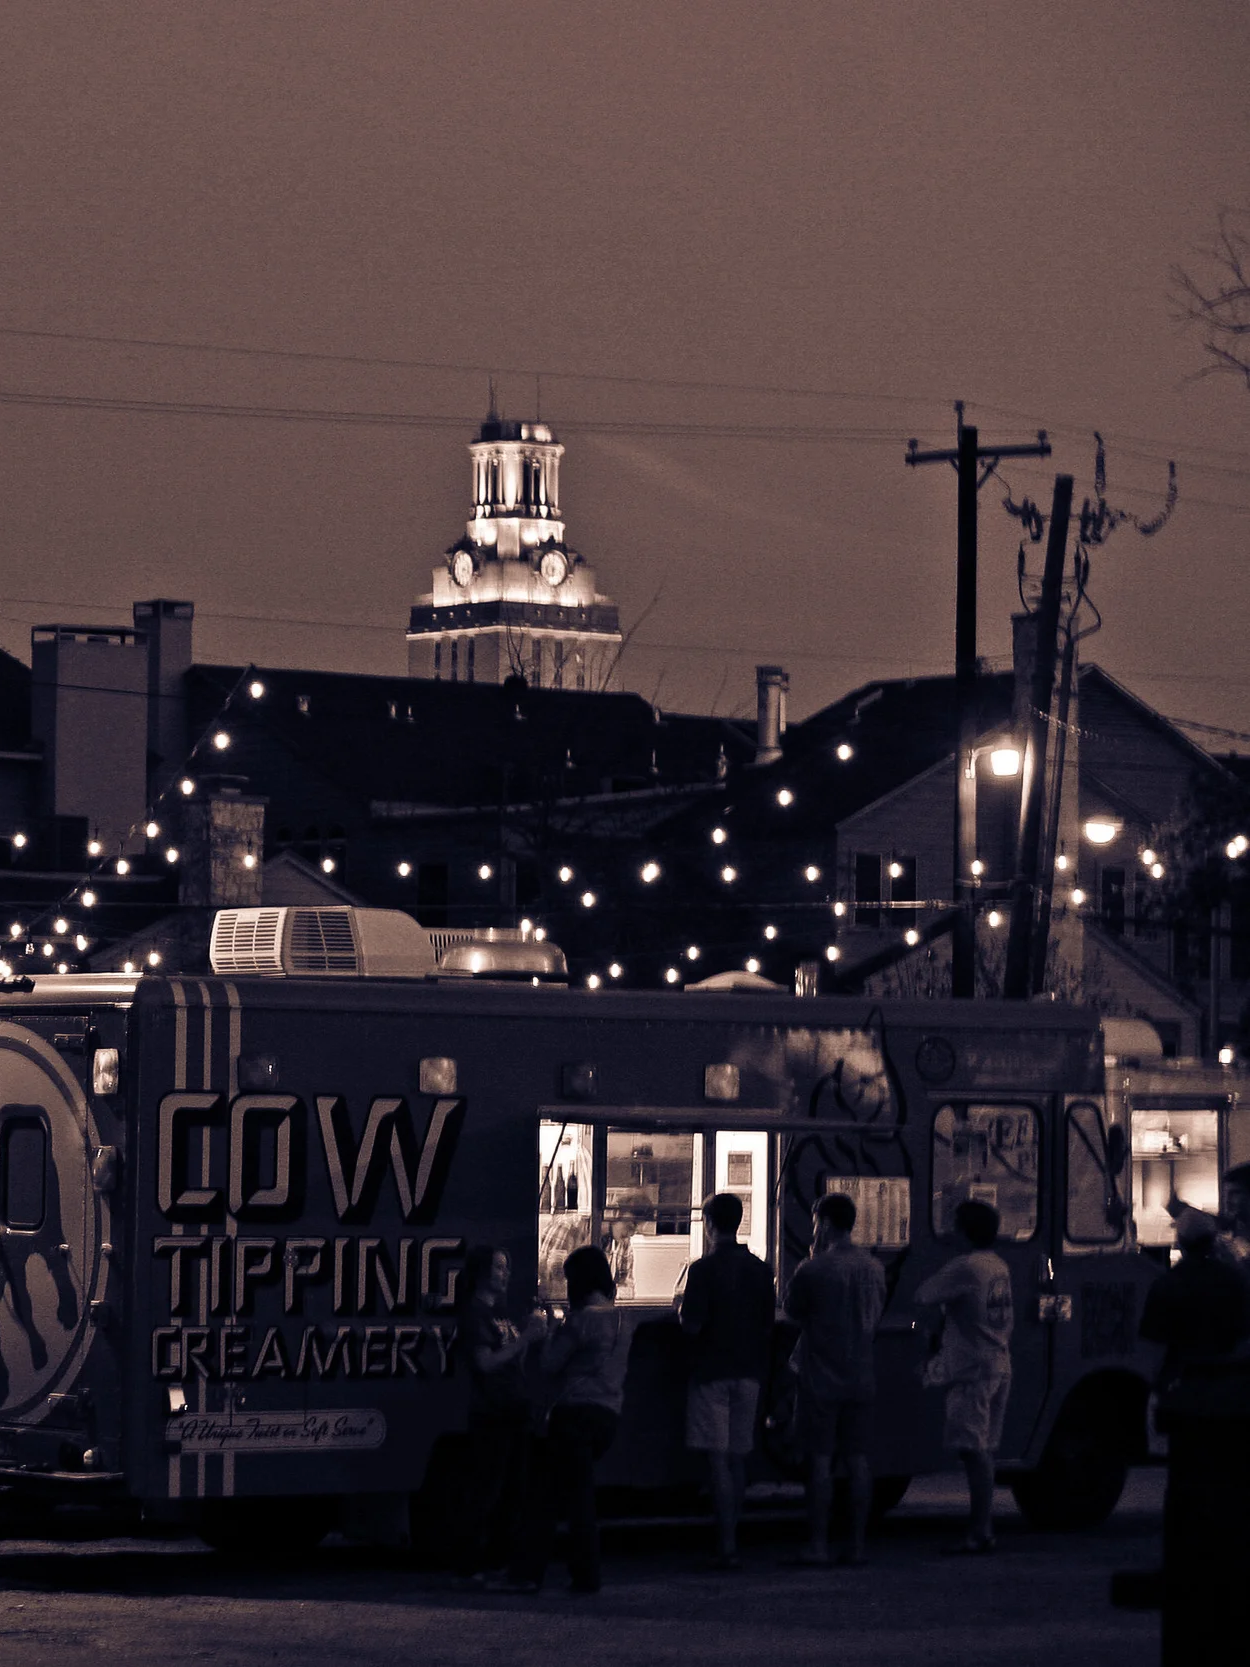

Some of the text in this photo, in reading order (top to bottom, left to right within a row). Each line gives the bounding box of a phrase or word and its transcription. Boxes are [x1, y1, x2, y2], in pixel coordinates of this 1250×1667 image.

[157, 1091, 463, 1222] COW
[153, 1236, 463, 1315] TIPPING
[152, 1326, 458, 1379] CREAMERY
[197, 1419, 243, 1446] Unique
[246, 1417, 280, 1441] Twist
[283, 1429, 296, 1438] on
[301, 1416, 330, 1443] Soft
